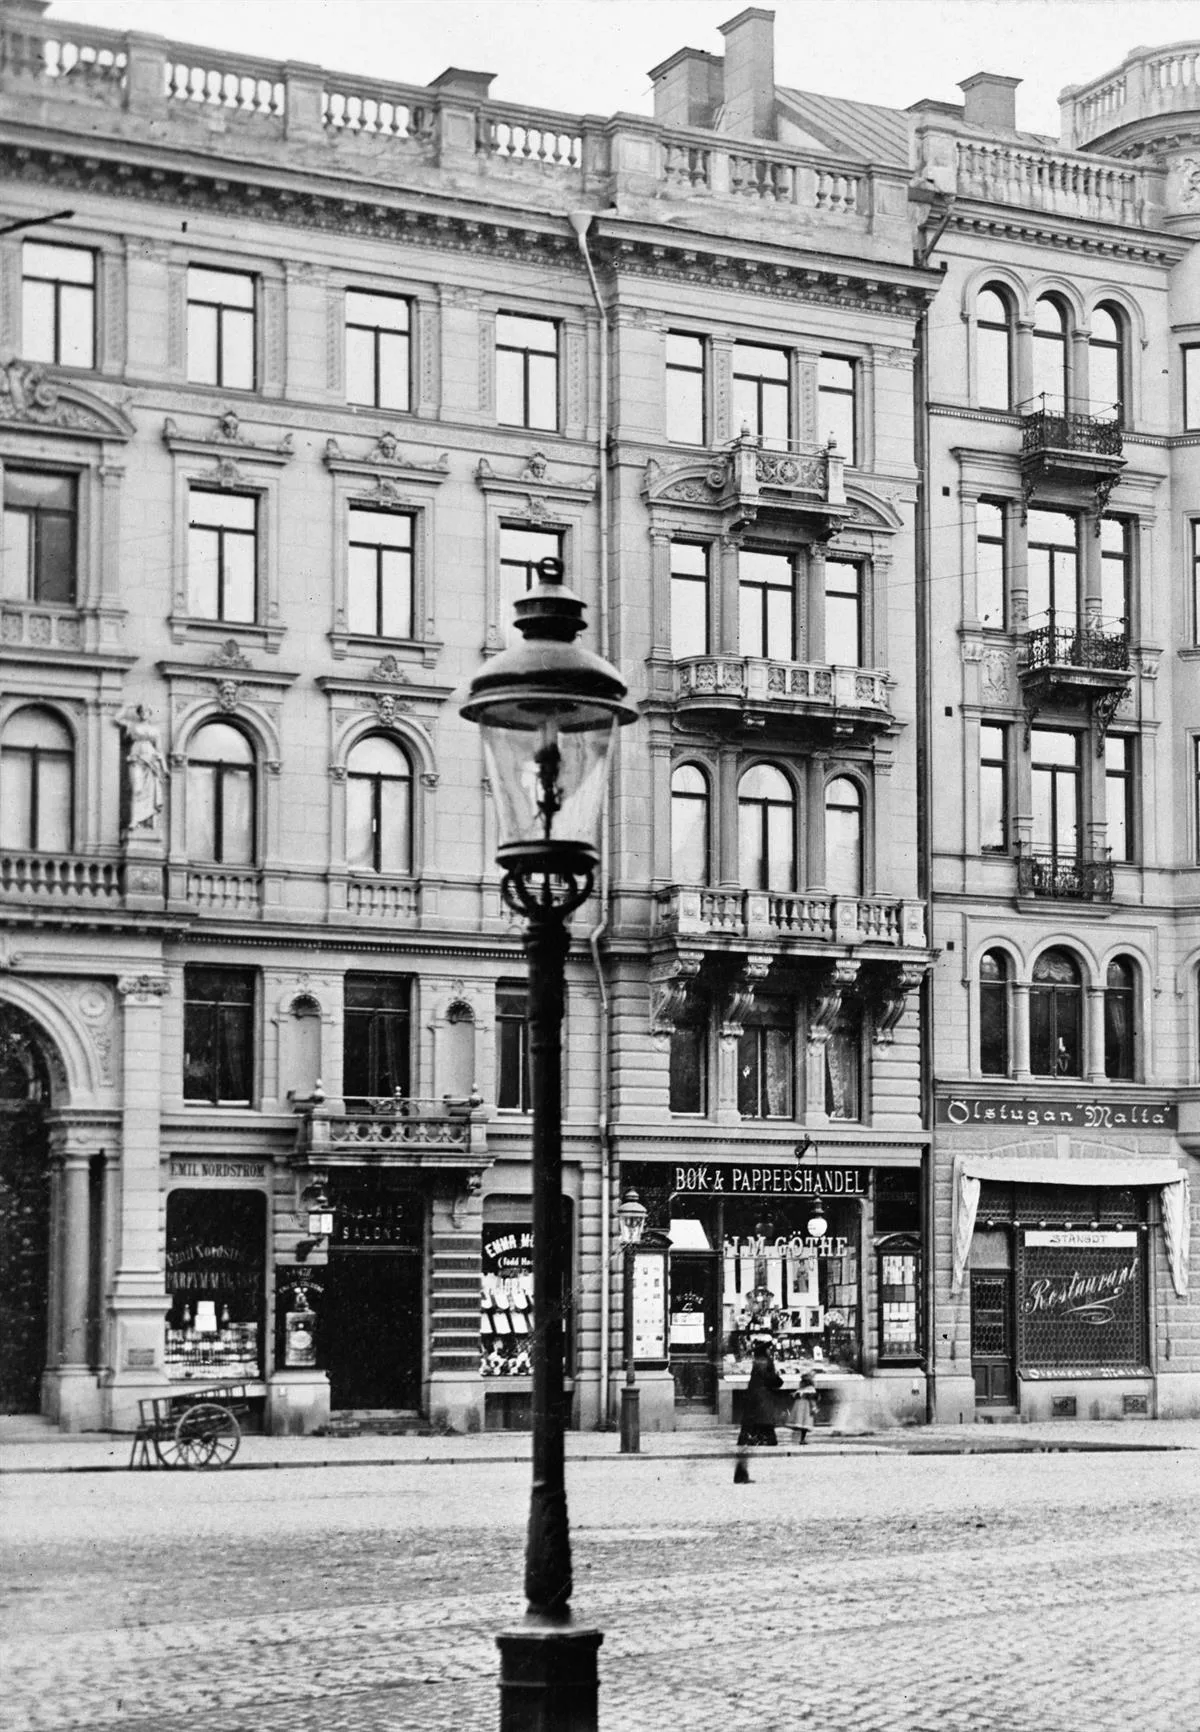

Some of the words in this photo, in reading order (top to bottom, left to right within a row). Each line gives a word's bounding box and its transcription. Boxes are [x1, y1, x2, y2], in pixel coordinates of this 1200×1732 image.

[948, 1100, 1073, 1125] Ölstugan
[171, 1163, 199, 1176] EMIL
[732, 1168, 865, 1193] PAPPERSHANDEL
[485, 1233, 517, 1258] EMMA
[1021, 1256, 1140, 1315] Restaurant
